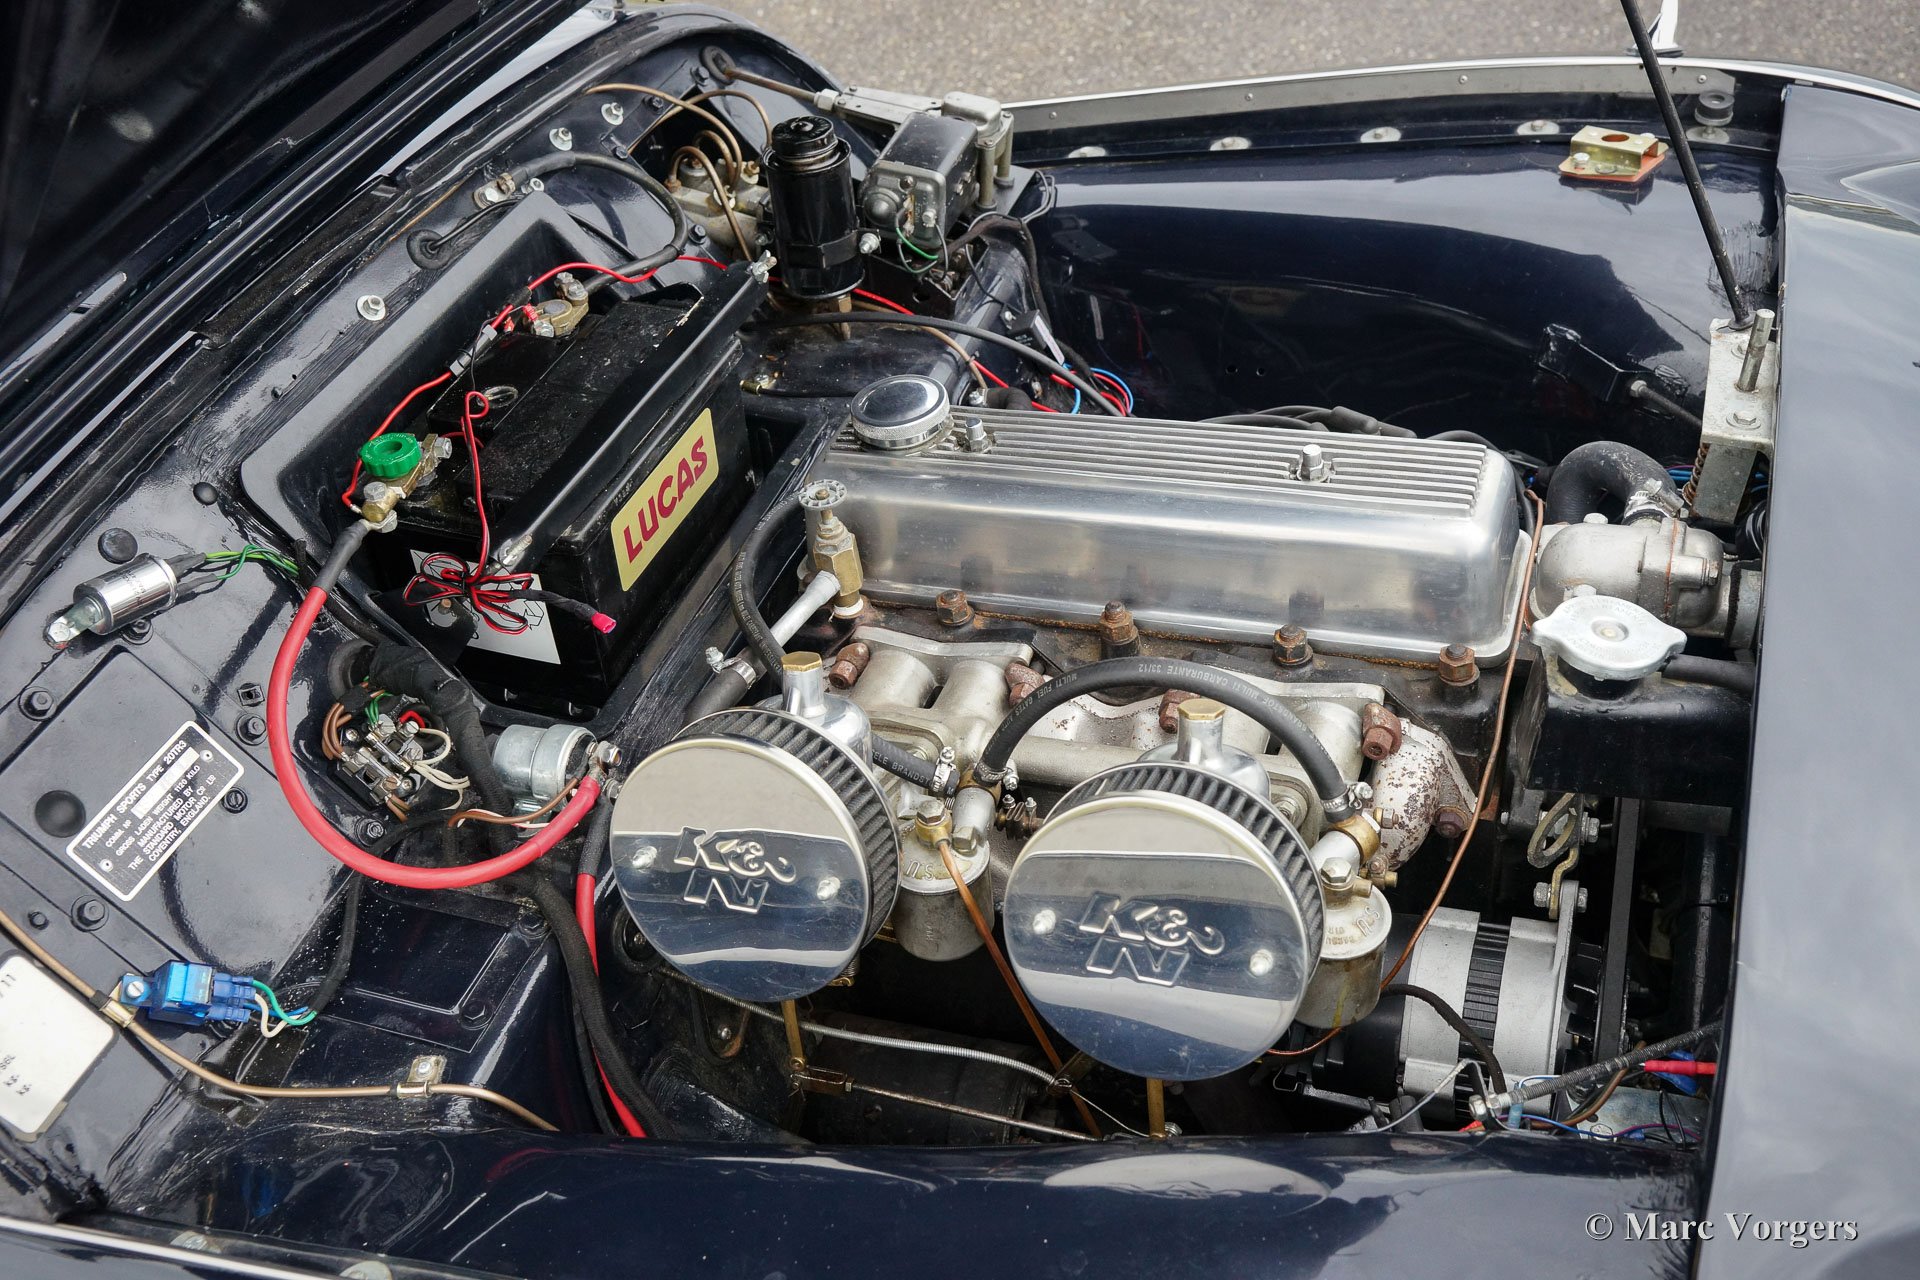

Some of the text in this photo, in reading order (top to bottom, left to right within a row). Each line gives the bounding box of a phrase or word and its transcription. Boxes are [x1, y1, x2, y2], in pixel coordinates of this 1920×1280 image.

[623, 435, 709, 564] LUCAS
[1036, 685, 1053, 699] FUEL
[1055, 672, 1078, 689] MULTI
[1166, 664, 1228, 686] CARBURANTE
[1231, 680, 1258, 700] MULTI
[82, 740, 187, 849] TRIUMPH SPORTS TYPE 20TR3
[892, 756, 932, 787] BRANDST
[115, 765, 201, 857] GROSS LADEN WEIGHT 1120 KILO
[127, 855, 144, 871] THE
[143, 821, 175, 855] STANDARD
[173, 796, 197, 821] MOTOR
[137, 785, 194, 848] MANUFACTURED BY
[148, 795, 211, 862] COVENTRY, ENGLAND.
